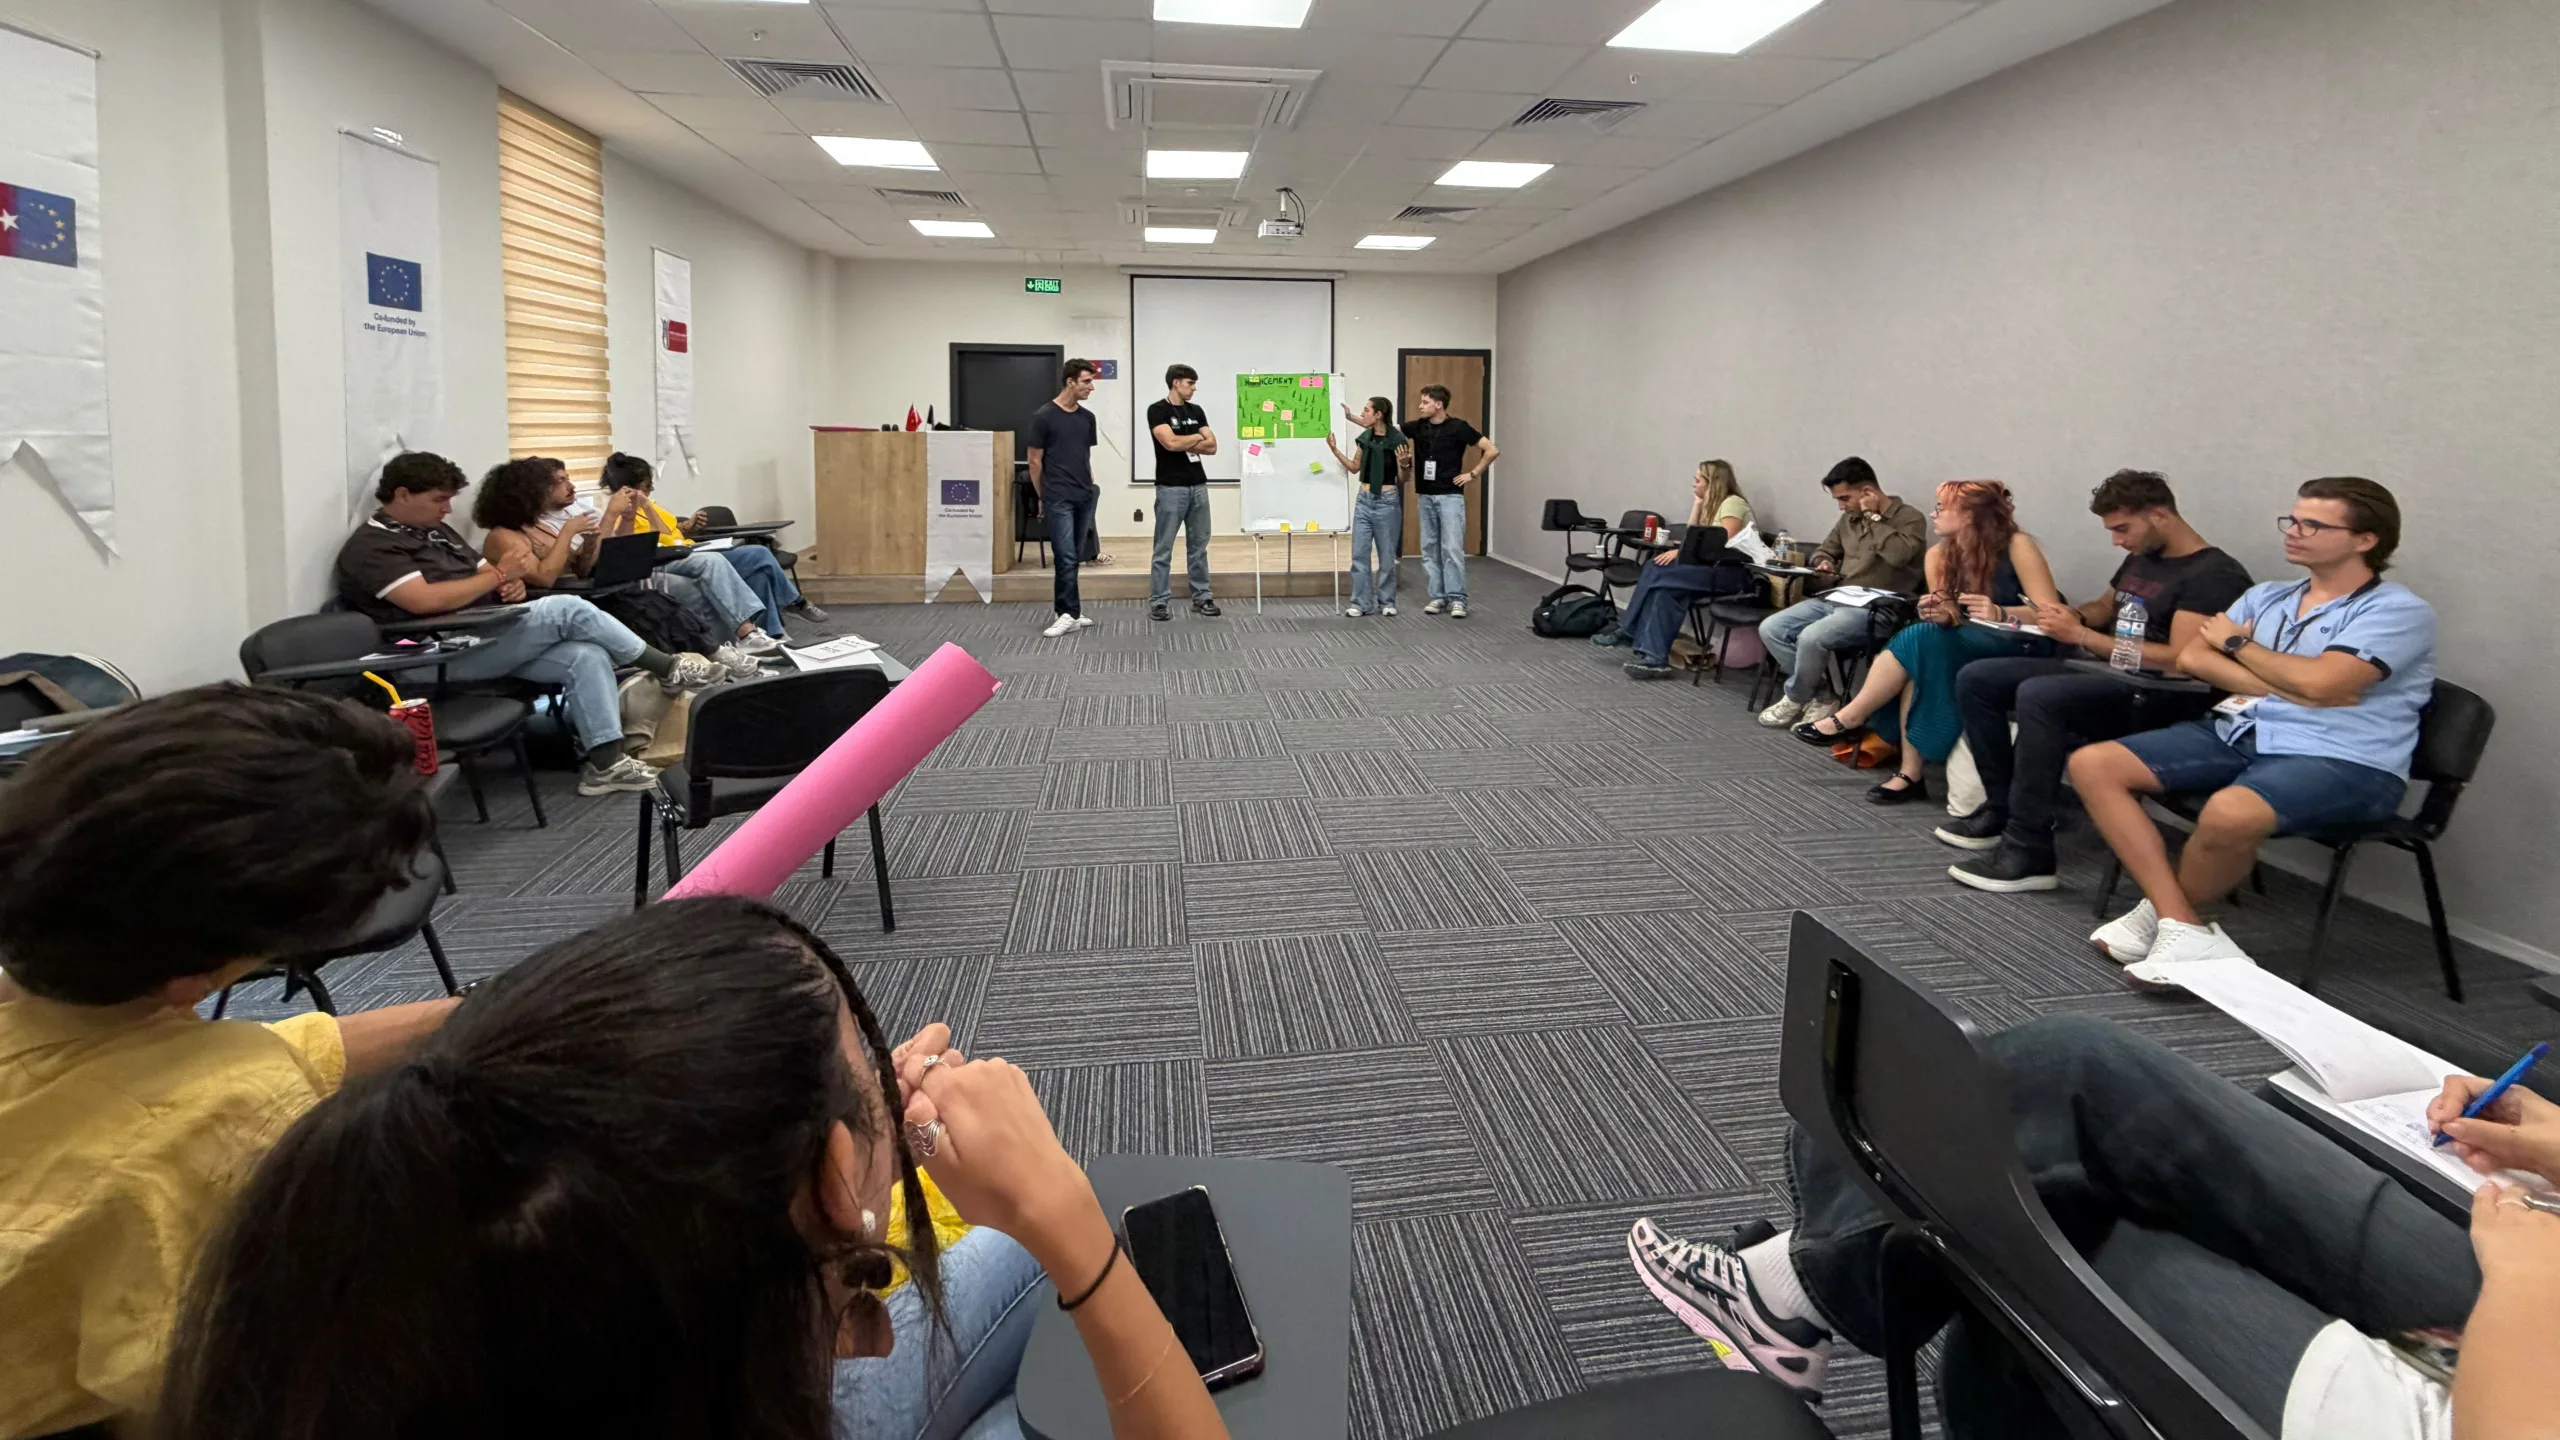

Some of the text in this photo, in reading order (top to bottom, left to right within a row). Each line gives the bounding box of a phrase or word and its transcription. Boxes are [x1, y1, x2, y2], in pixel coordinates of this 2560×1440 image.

[373, 312, 417, 328] Co-funded by
[364, 321, 427, 337] the European Union
